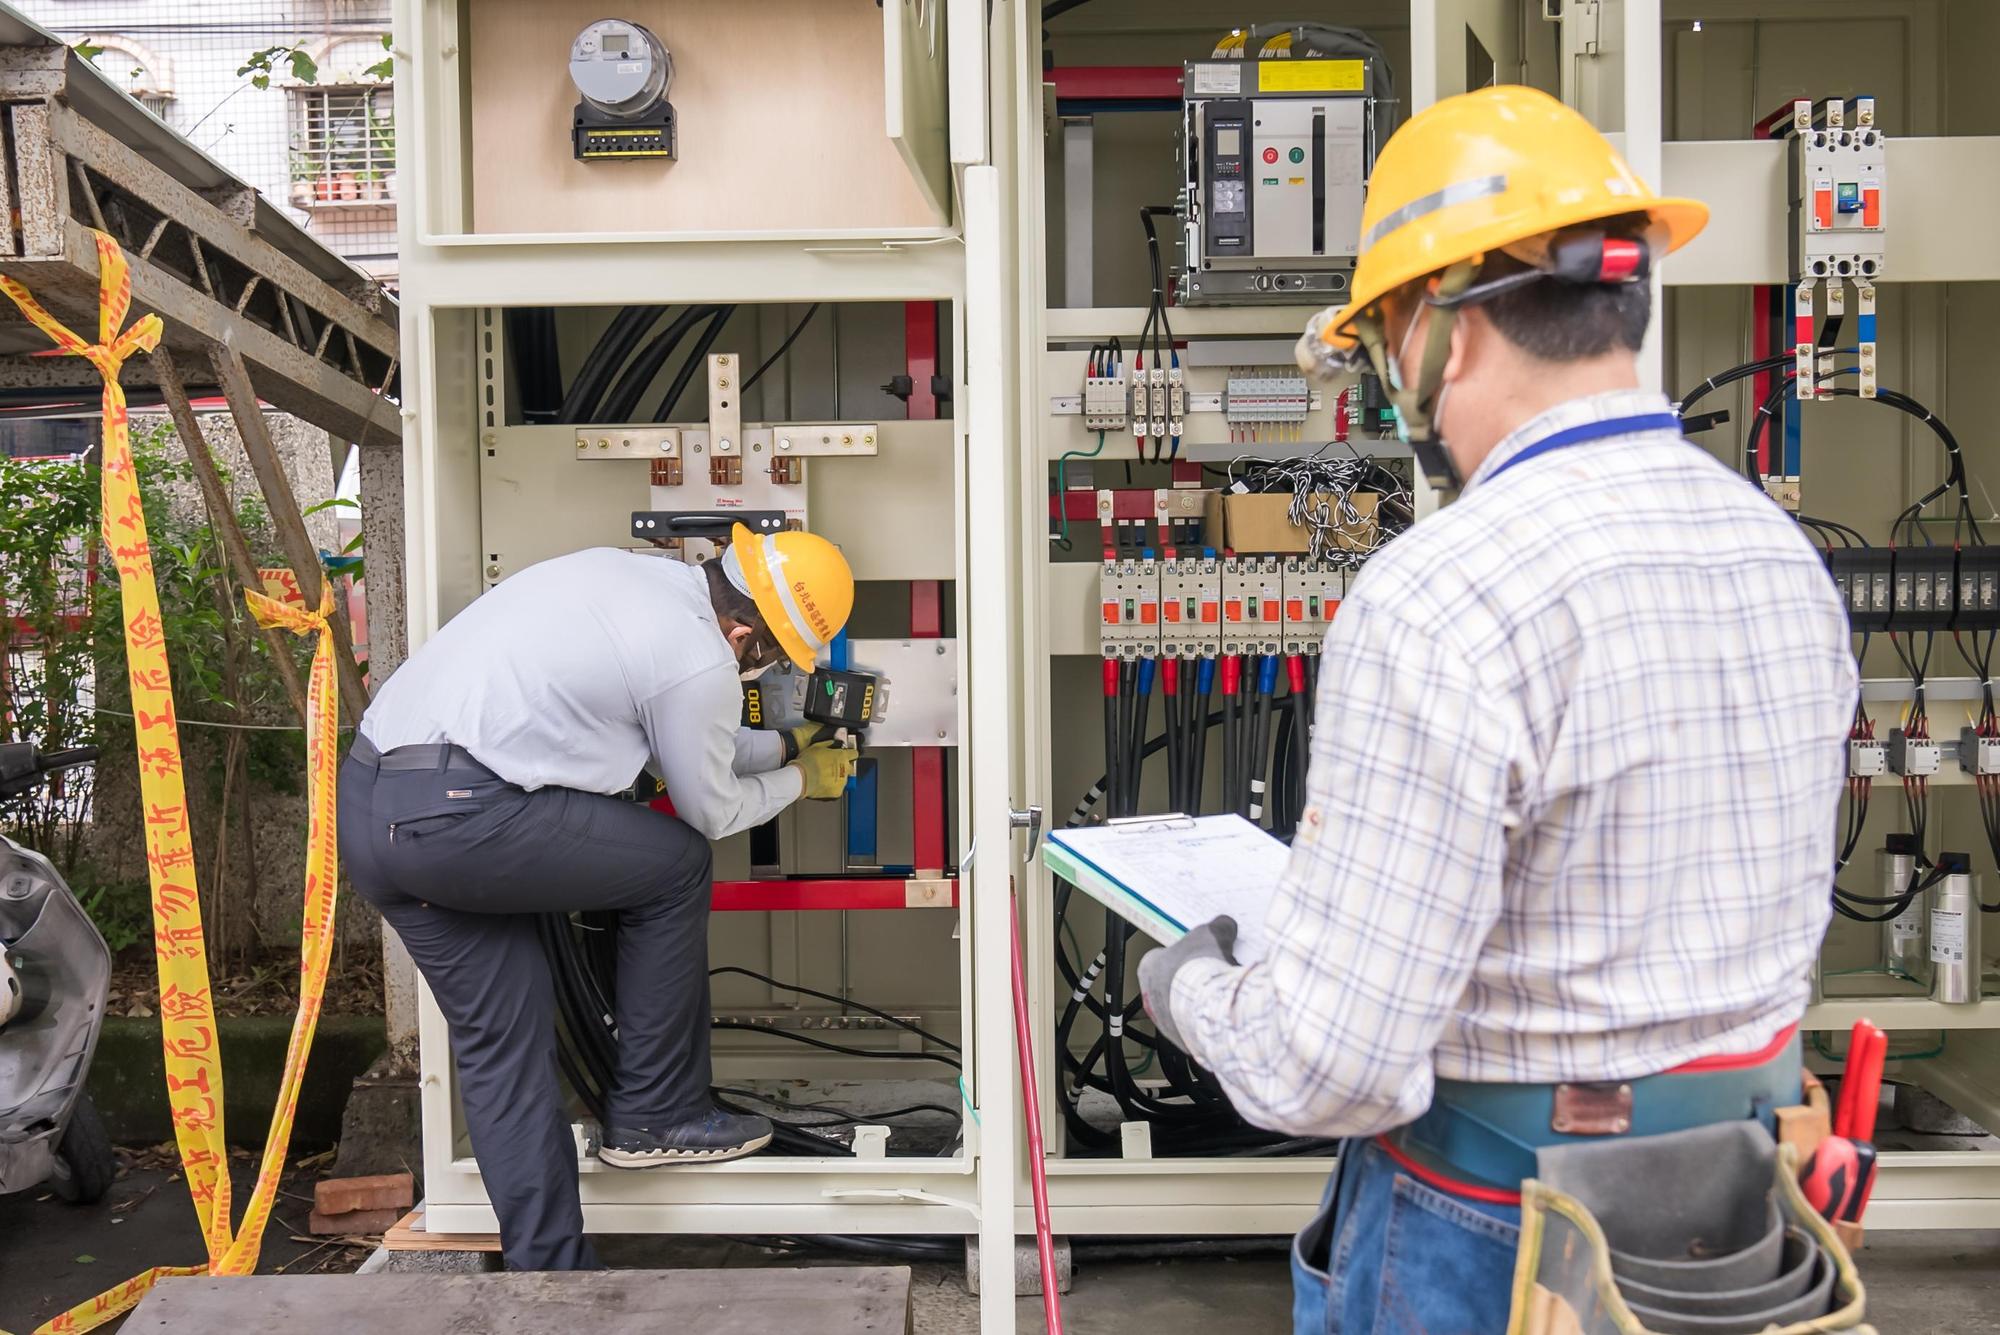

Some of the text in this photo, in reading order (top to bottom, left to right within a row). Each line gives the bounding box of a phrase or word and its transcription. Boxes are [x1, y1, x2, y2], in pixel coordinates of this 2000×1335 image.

[129, 605, 180, 779] 施工危險
[748, 689, 761, 723] 800
[861, 685, 874, 720] 800
[147, 798, 203, 960] 請勿靠近
